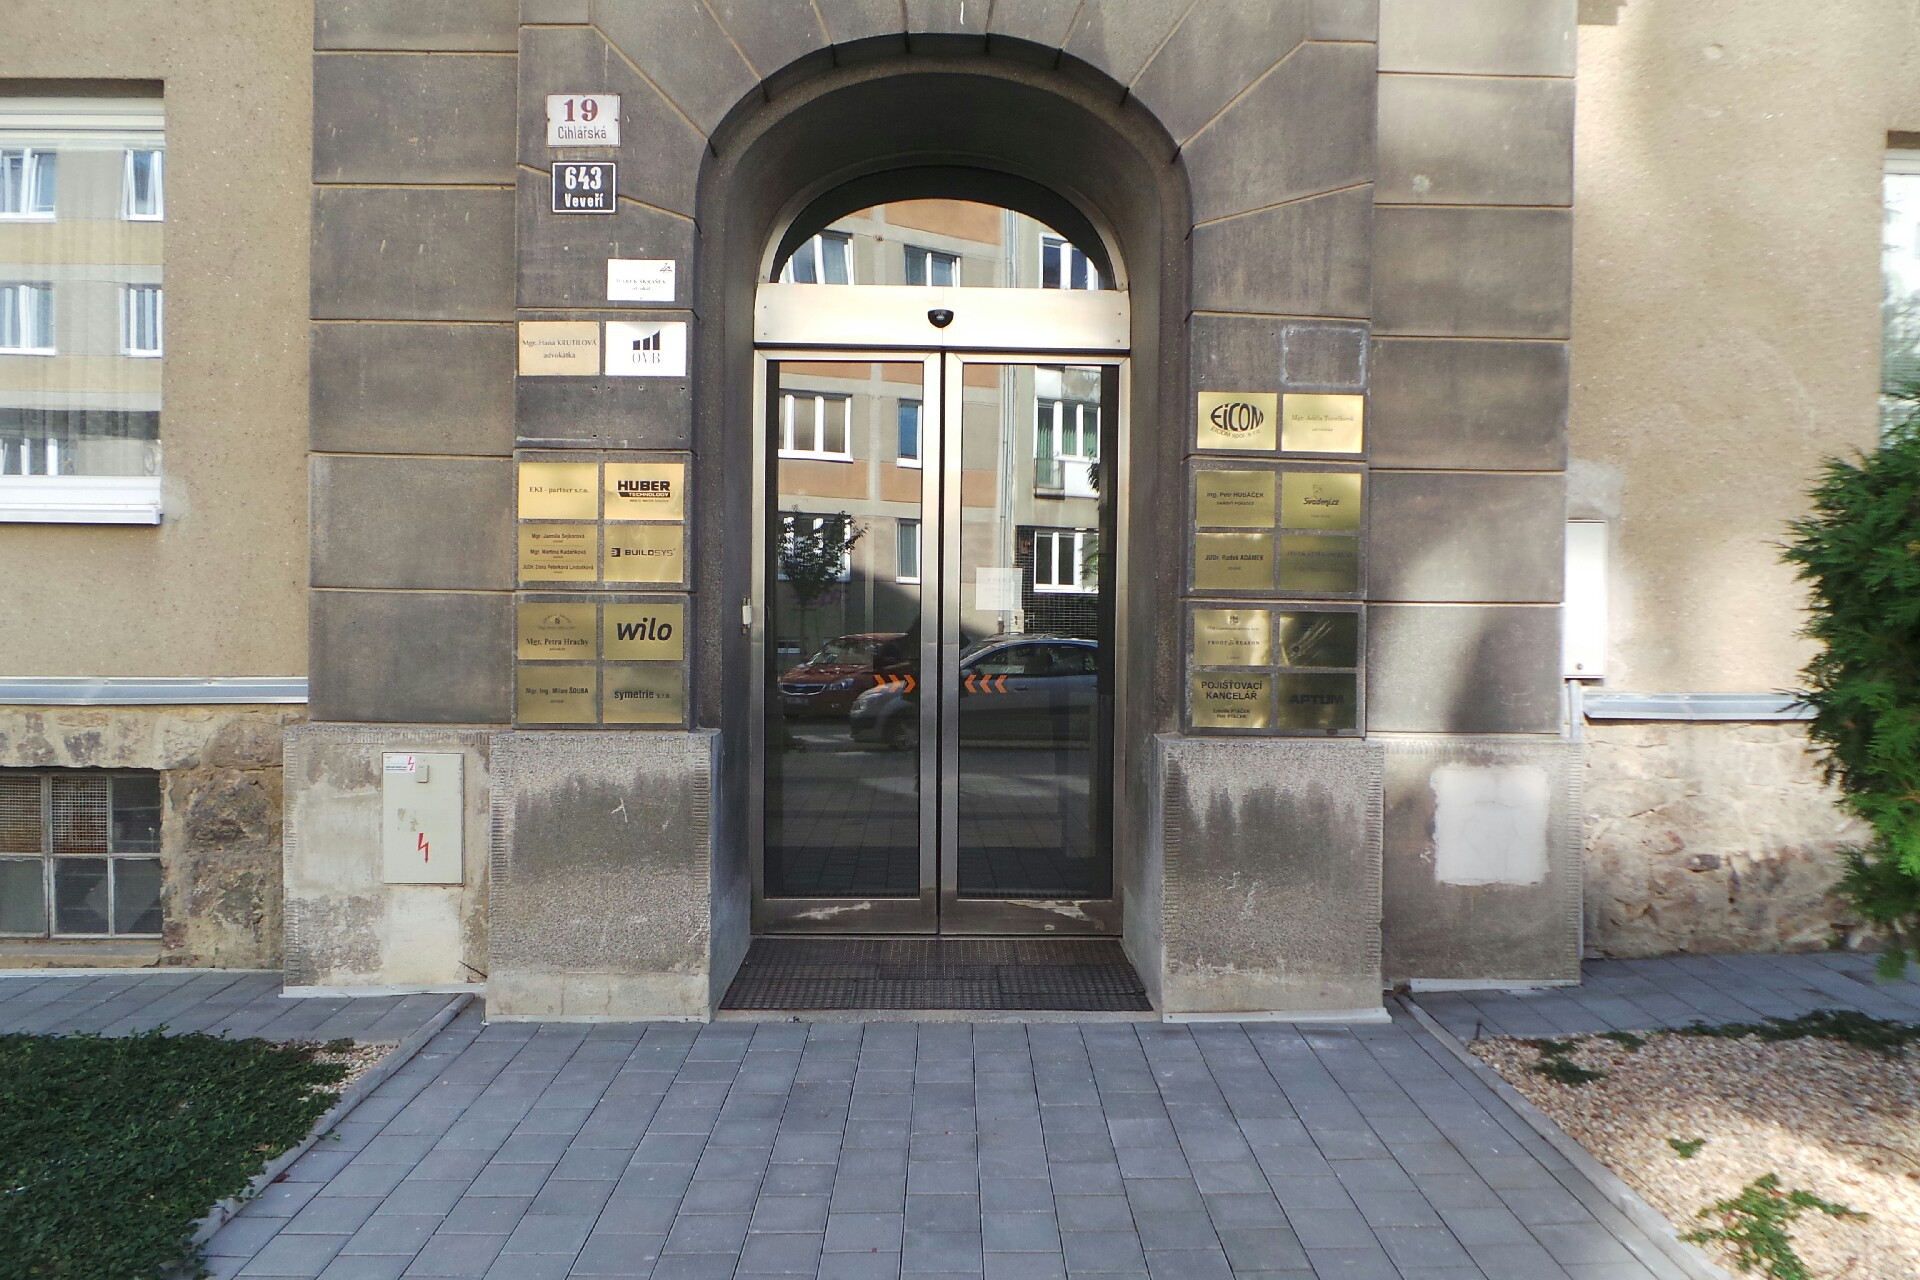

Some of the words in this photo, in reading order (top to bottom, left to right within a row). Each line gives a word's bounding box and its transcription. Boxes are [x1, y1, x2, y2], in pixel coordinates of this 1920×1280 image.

[564, 98, 599, 122] 19
[557, 126, 607, 139] Cihlářská
[564, 166, 602, 190] 643
[564, 193, 604, 208] Veveří
[632, 352, 661, 364] OVB
[548, 486, 573, 494] partner
[617, 480, 671, 491] HUBER
[625, 548, 674, 557] BUILDSYS
[617, 616, 672, 642] wilo
[526, 638, 542, 646] Mgr.
[1201, 680, 1263, 690] POJIŠŤOVACÍ
[614, 689, 654, 701] symetrie
[1206, 690, 1257, 700] KANCELÁŘ
